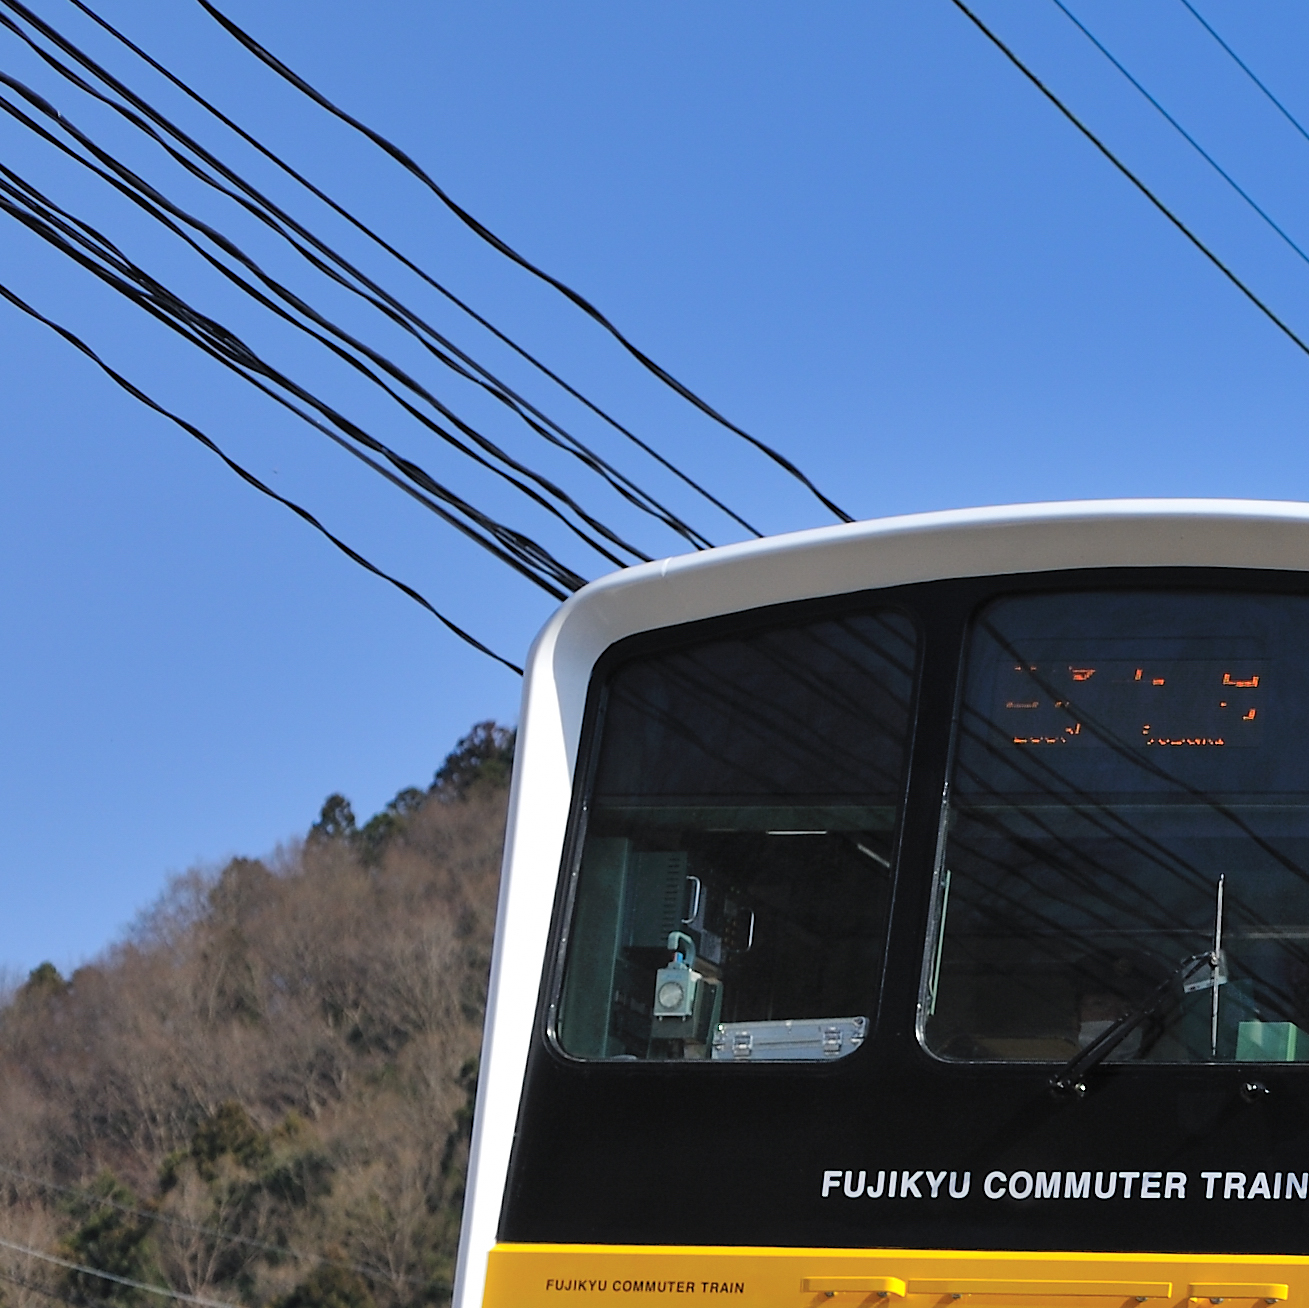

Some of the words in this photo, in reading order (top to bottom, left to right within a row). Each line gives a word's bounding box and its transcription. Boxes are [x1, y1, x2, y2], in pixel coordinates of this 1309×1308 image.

[821, 1169, 972, 1201] FUJIKYU
[983, 1169, 1188, 1202] COMMUTER
[1199, 1170, 1309, 1202] TRAIN
[545, 1279, 608, 1292] FUJIKYU
[612, 1280, 696, 1294] COMMUTER
[701, 1282, 745, 1294] TRAIN
